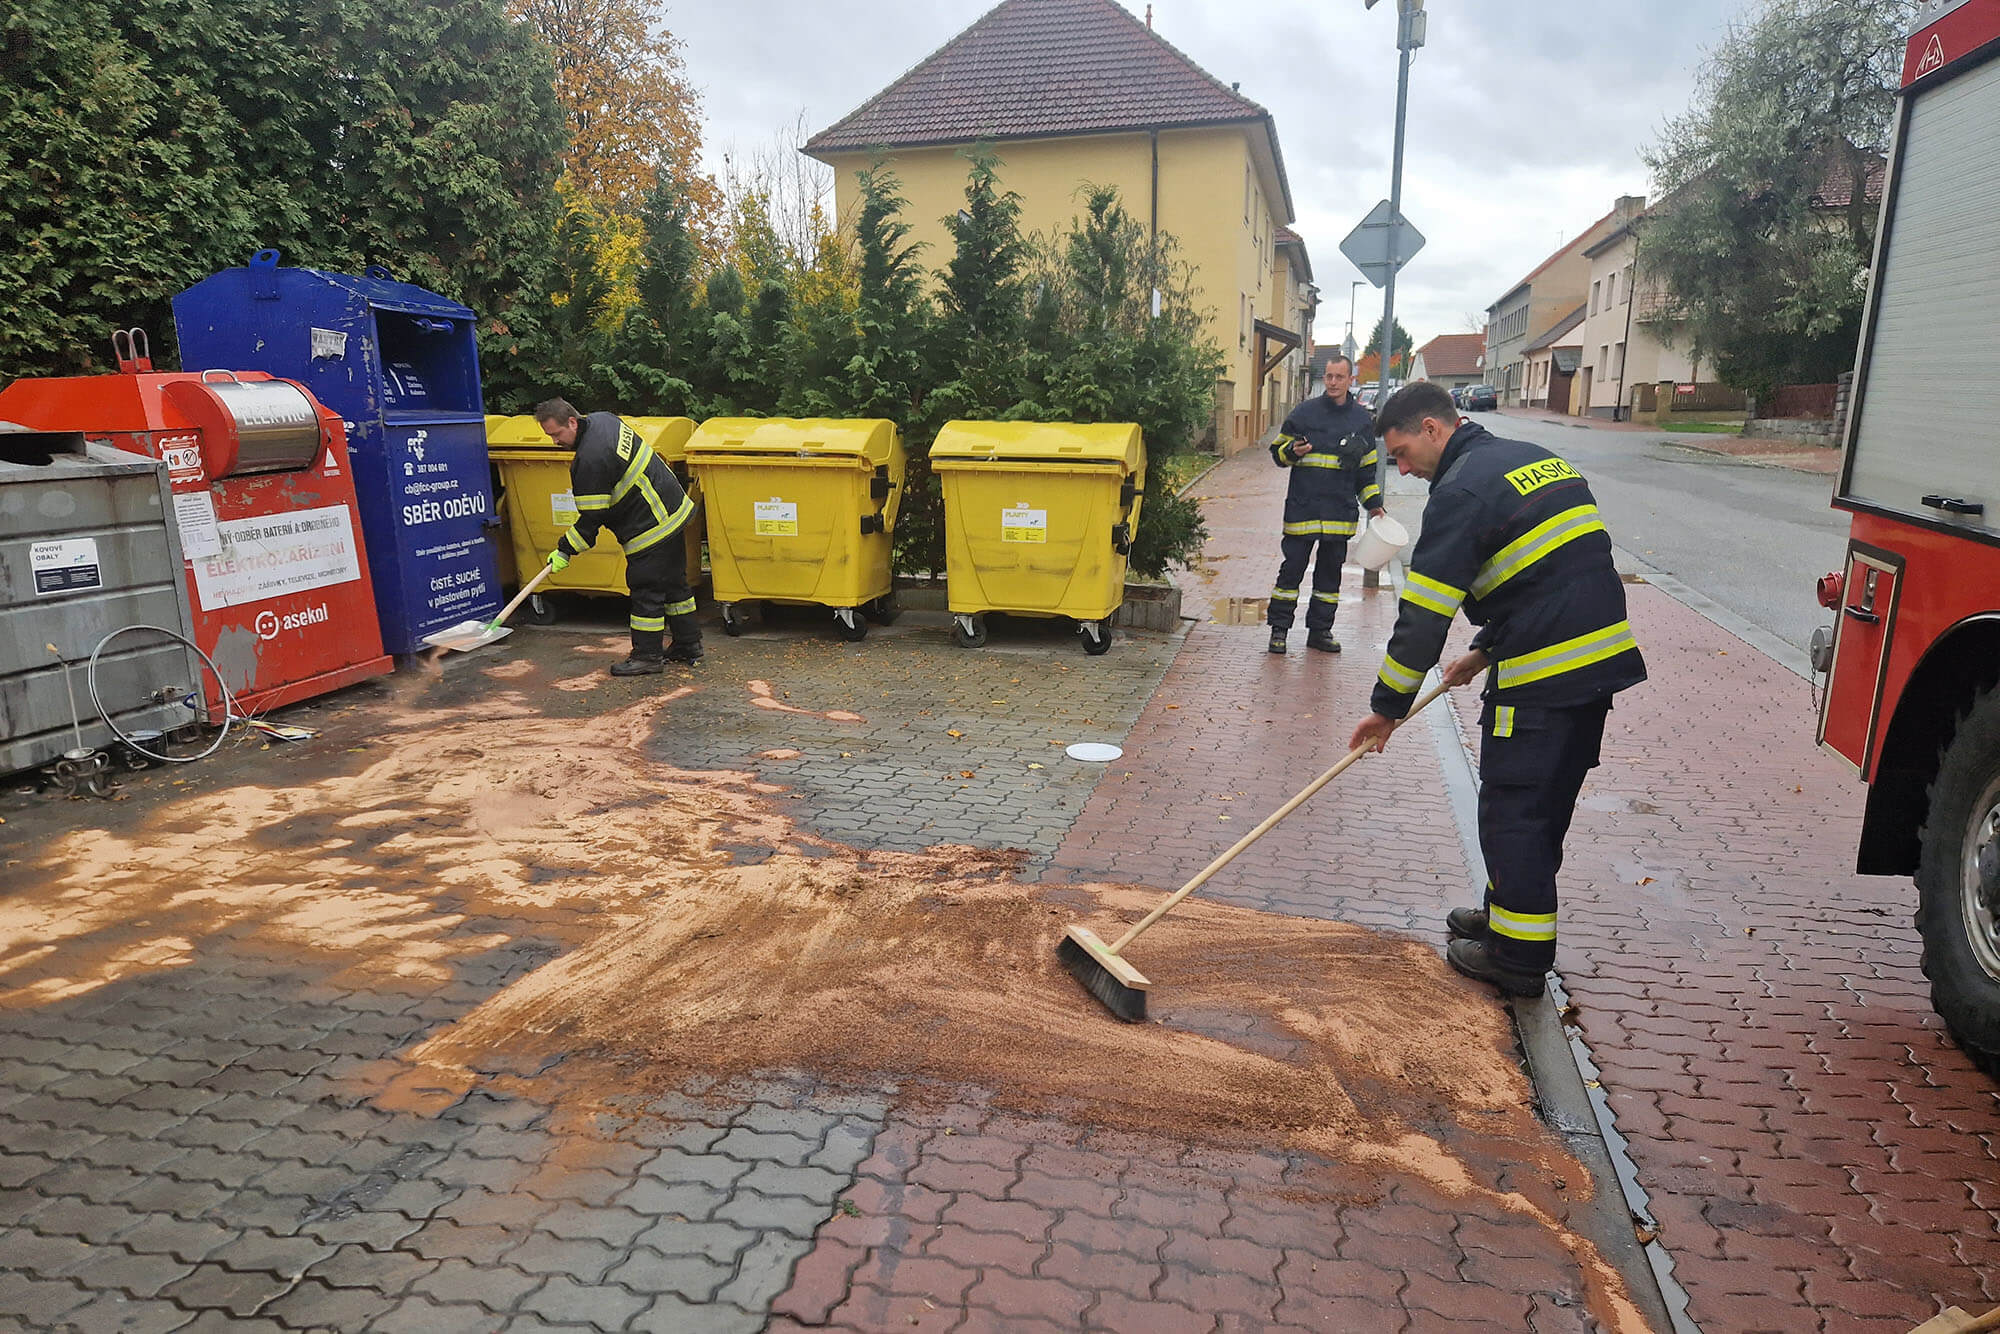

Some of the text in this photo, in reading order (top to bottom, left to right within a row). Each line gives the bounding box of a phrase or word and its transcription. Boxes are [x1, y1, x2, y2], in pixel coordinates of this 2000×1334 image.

[403, 491, 486, 526] SBĚR ODĚVŮ
[235, 526, 262, 542] ODBĚR
[294, 523, 300, 534] A
[456, 566, 481, 586] SUCHÉ
[434, 588, 471, 608] plastovém
[283, 603, 329, 630] asekol
